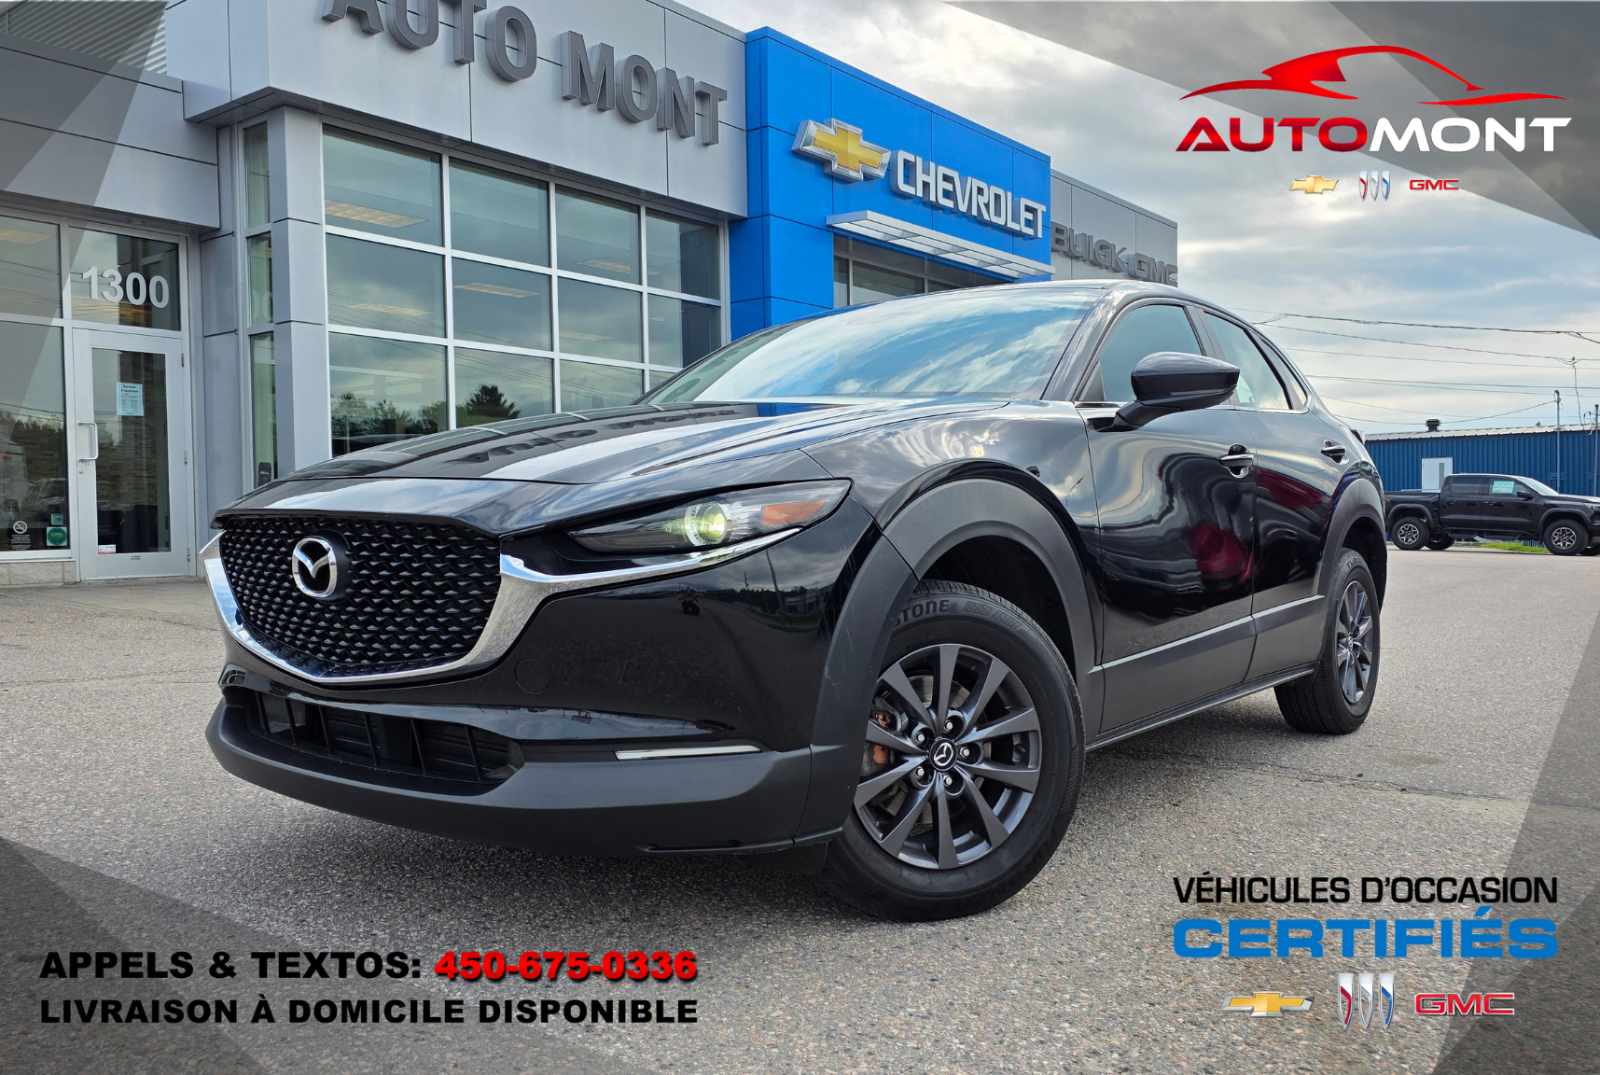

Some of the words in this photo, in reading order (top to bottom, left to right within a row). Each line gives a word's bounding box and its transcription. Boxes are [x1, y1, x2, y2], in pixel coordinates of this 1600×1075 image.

[560, 30, 727, 146] MONT
[891, 149, 1047, 239] CHEVROLET
[82, 266, 170, 309] 1300
[1051, 221, 1128, 273] BUICK
[1126, 252, 1178, 287] GMC
